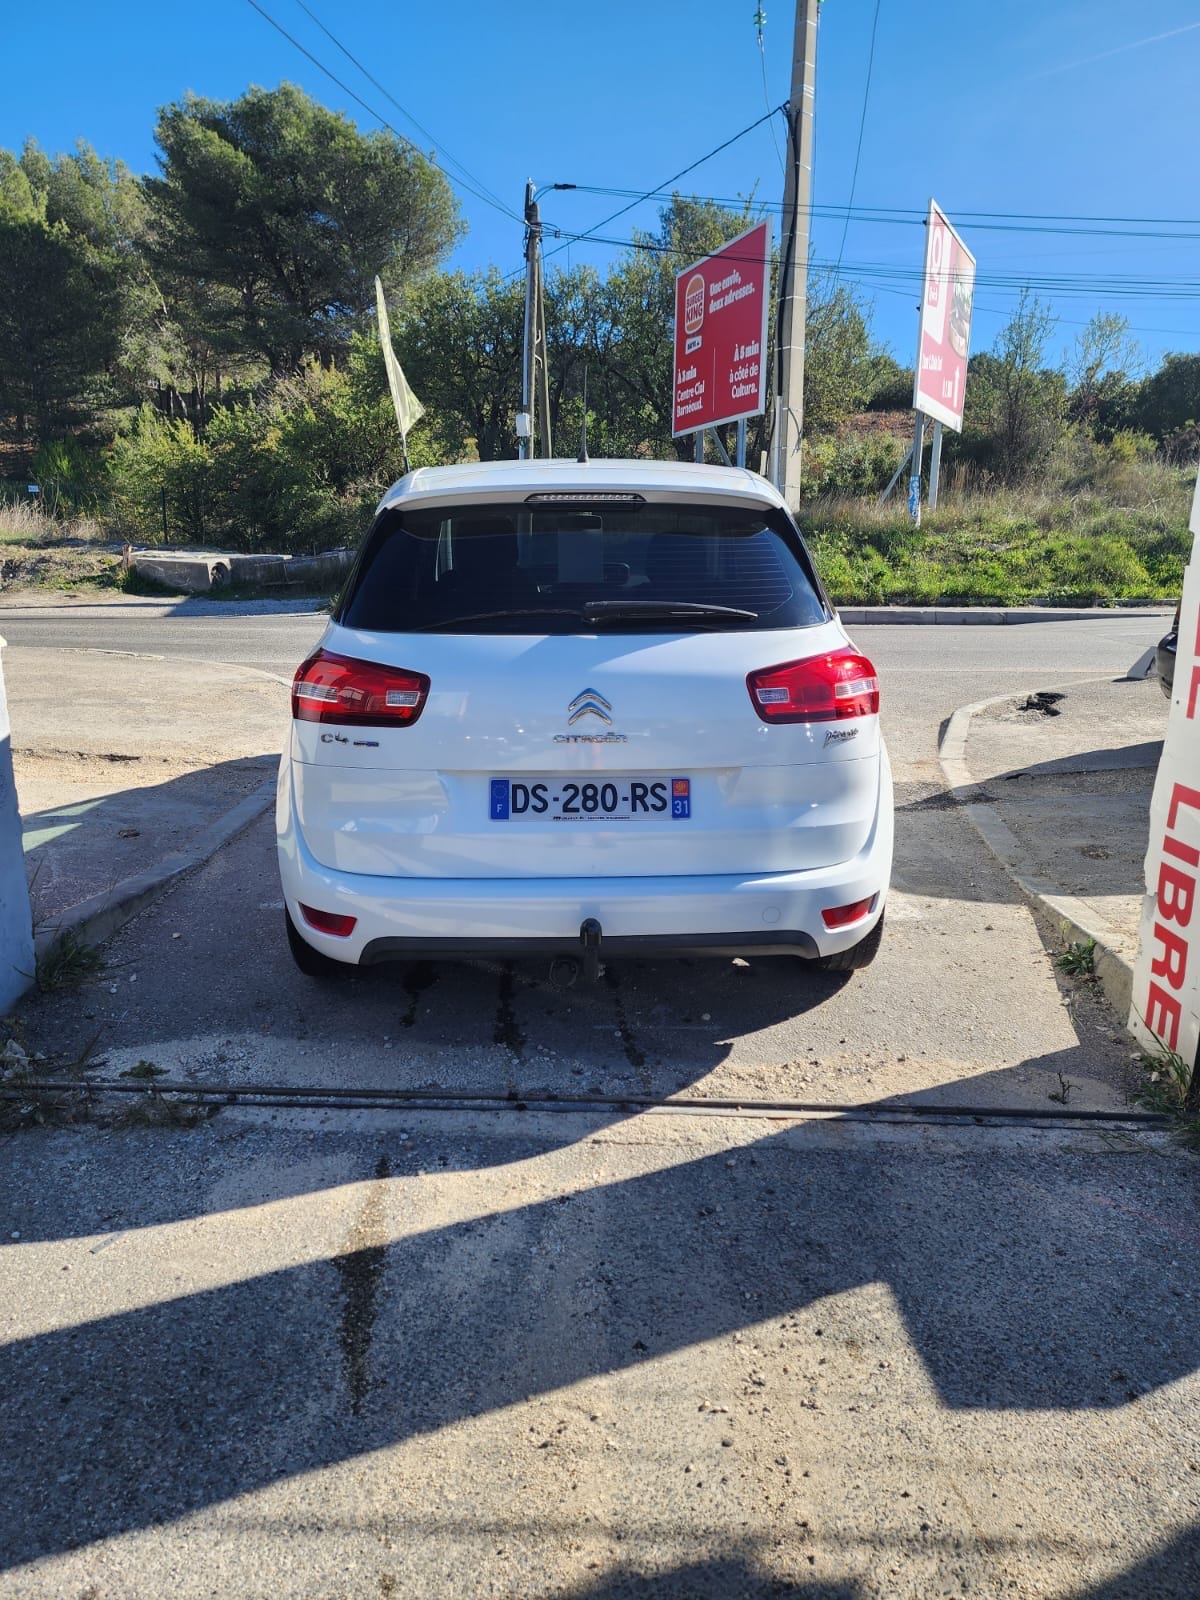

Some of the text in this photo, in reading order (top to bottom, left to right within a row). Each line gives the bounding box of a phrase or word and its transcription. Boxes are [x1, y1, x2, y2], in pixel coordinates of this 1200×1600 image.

[709, 269, 741, 297] Une envie,
[686, 290, 704, 309] BURGER
[709, 282, 755, 314] deux adresses.
[686, 302, 703, 324] KING
[745, 340, 760, 358] min
[686, 365, 697, 381] min
[729, 362, 759, 384] à côté de
[677, 388, 695, 403] Centre
[731, 382, 758, 399] Cultura.
[320, 731, 349, 745] C4
[496, 803, 503, 813] F
[511, 782, 668, 813] DS-280-RS
[674, 800, 689, 815] 31
[1145, 782, 1200, 1052] LIBRE
